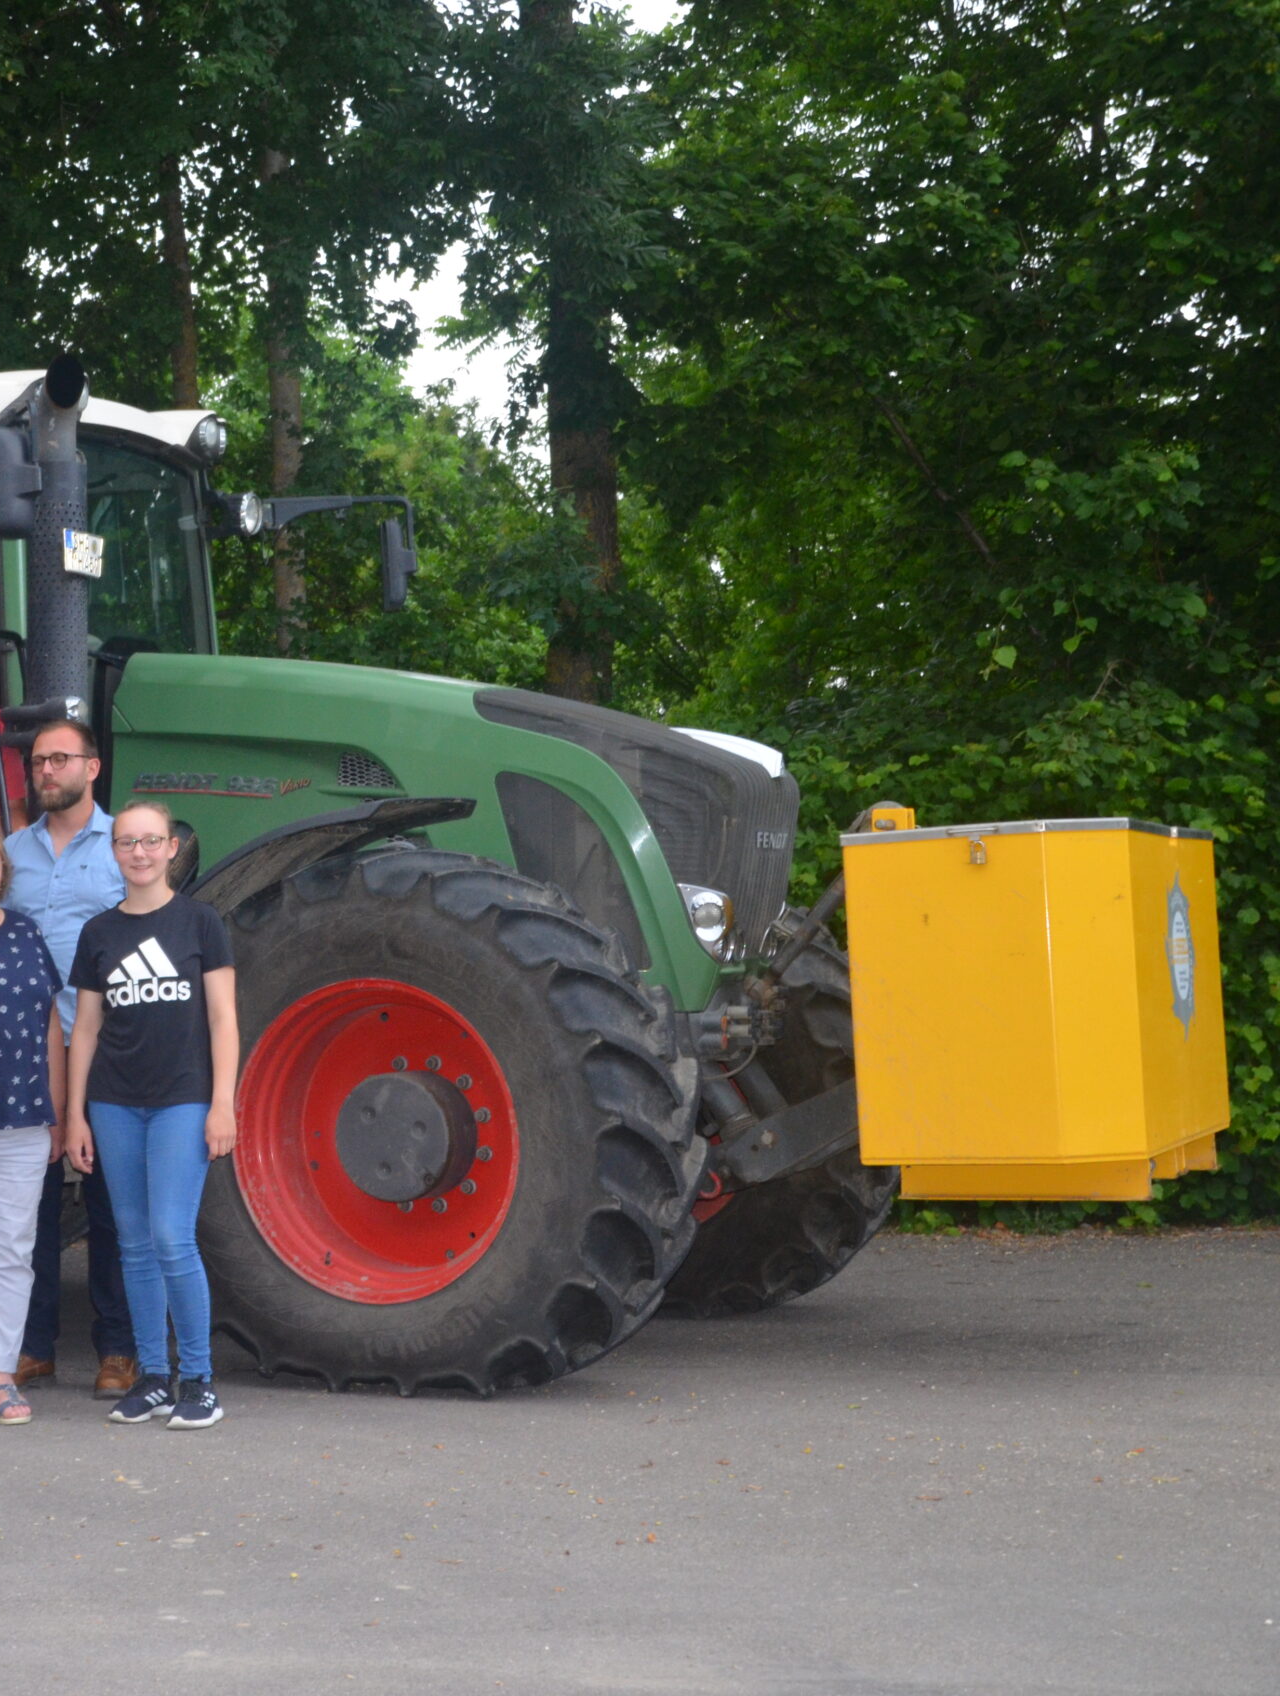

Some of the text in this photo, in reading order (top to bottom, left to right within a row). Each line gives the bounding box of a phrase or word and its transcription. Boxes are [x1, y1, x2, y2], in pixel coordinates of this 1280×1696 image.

[133, 773, 218, 790] FENDT
[756, 831, 789, 849] FENDT
[106, 977, 191, 1009] adidas
